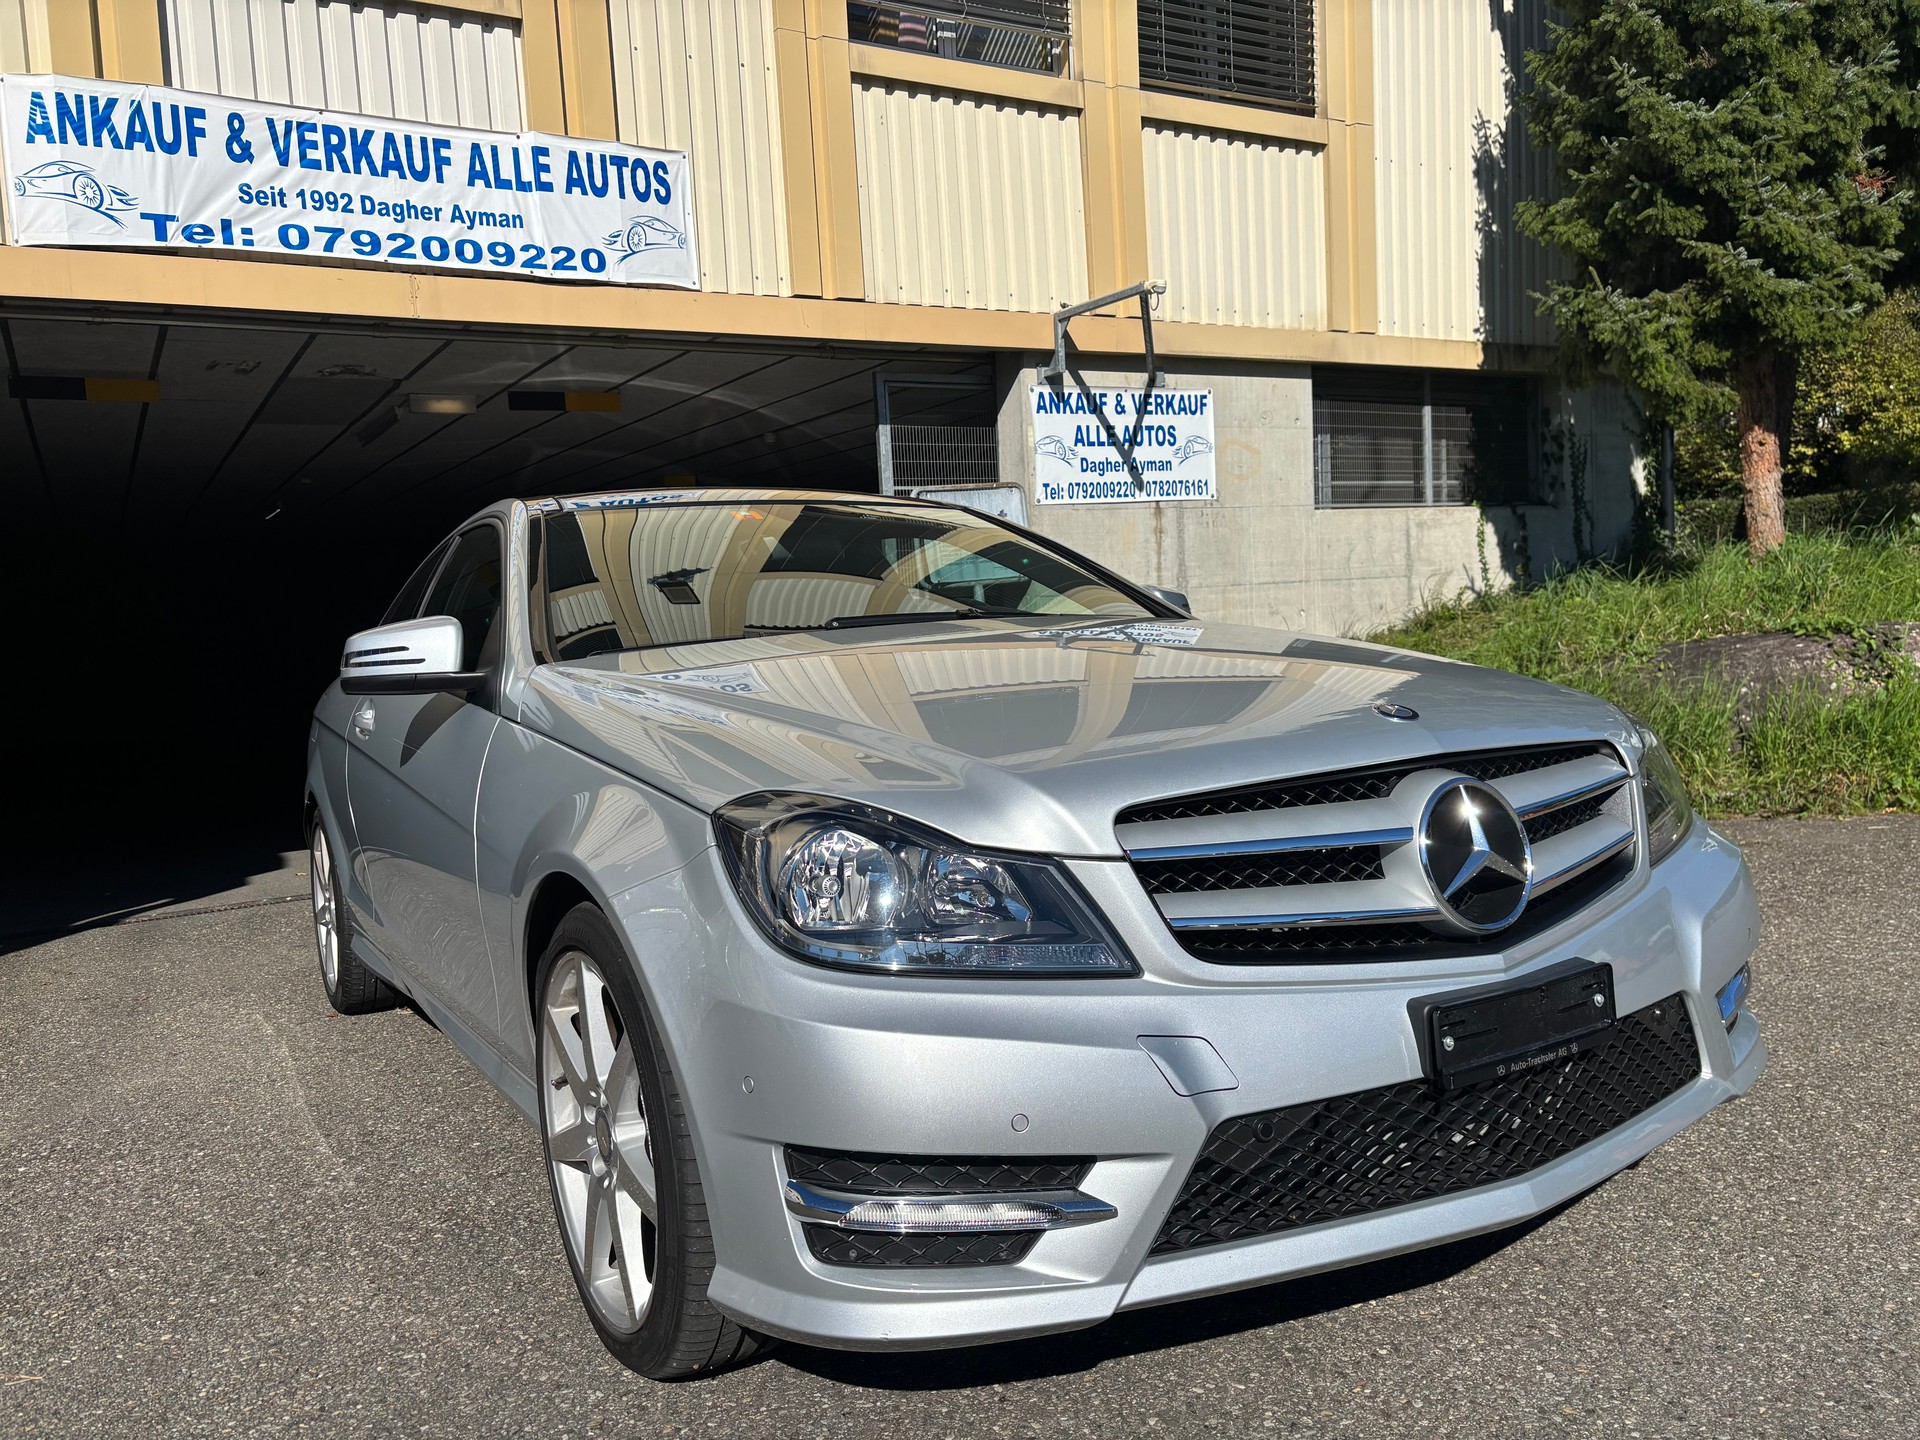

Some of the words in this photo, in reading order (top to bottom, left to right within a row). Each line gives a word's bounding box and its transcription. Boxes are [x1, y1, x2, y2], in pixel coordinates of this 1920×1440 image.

[26, 91, 206, 157] ANKAUF
[225, 112, 254, 164] &
[265, 117, 452, 184] VERKAUF
[467, 142, 554, 193] ALLE
[564, 151, 672, 206] AUTOS
[237, 182, 288, 209] Seit
[296, 188, 355, 215] 1992
[360, 194, 442, 226] Dagher
[450, 203, 524, 230] Ayman
[140, 212, 254, 248] Tel:
[277, 223, 607, 275] 0792009220
[1036, 391, 1107, 416] ANKAUF
[1114, 393, 1127, 416] &
[1131, 393, 1208, 416] VERKAUF
[1074, 424, 1117, 448] ALLE
[1122, 424, 1177, 448] AUTOS
[1080, 457, 1127, 477] Dagher
[1130, 457, 1173, 477] Ayman
[1042, 482, 1064, 500] Tel:
[1067, 482, 1136, 500] 0792009220
[1145, 479, 1209, 497] 0782076161
[1558, 1047, 1567, 1057] AG
